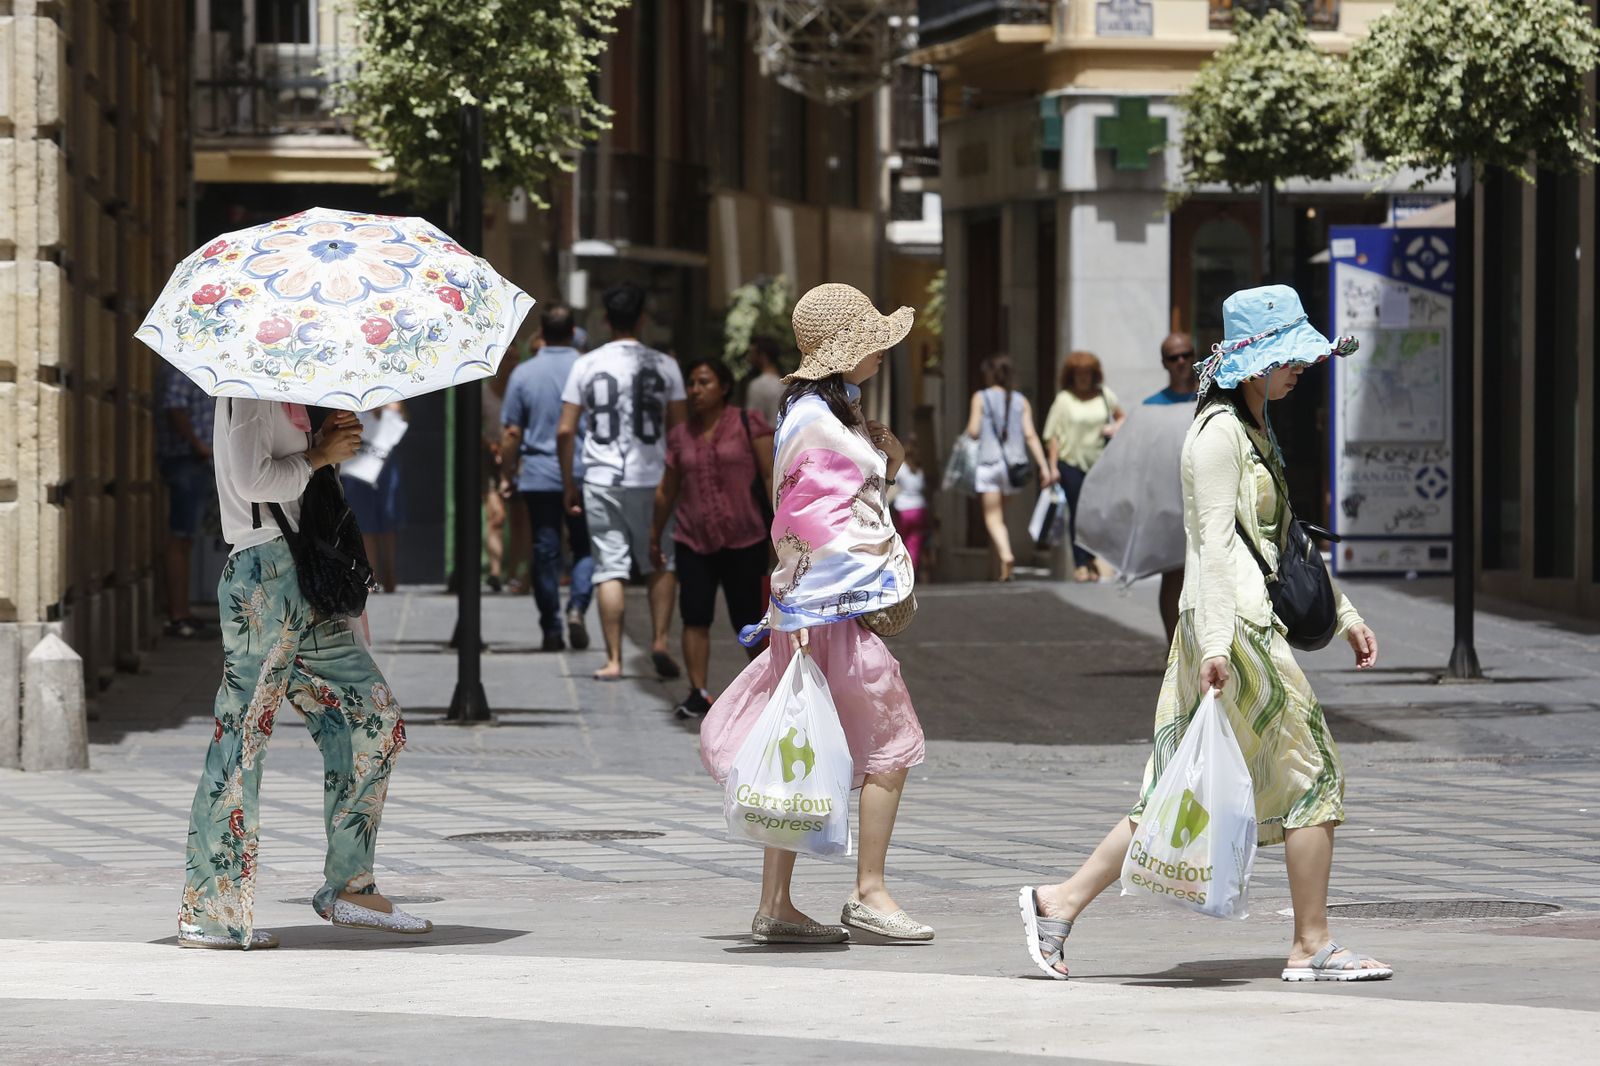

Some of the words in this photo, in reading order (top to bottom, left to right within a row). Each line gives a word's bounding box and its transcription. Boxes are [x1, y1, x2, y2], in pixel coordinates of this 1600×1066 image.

[586, 367, 665, 445] 86
[737, 784, 832, 812] Carrefour
[744, 812, 824, 832] express
[1132, 873, 1207, 905] express
